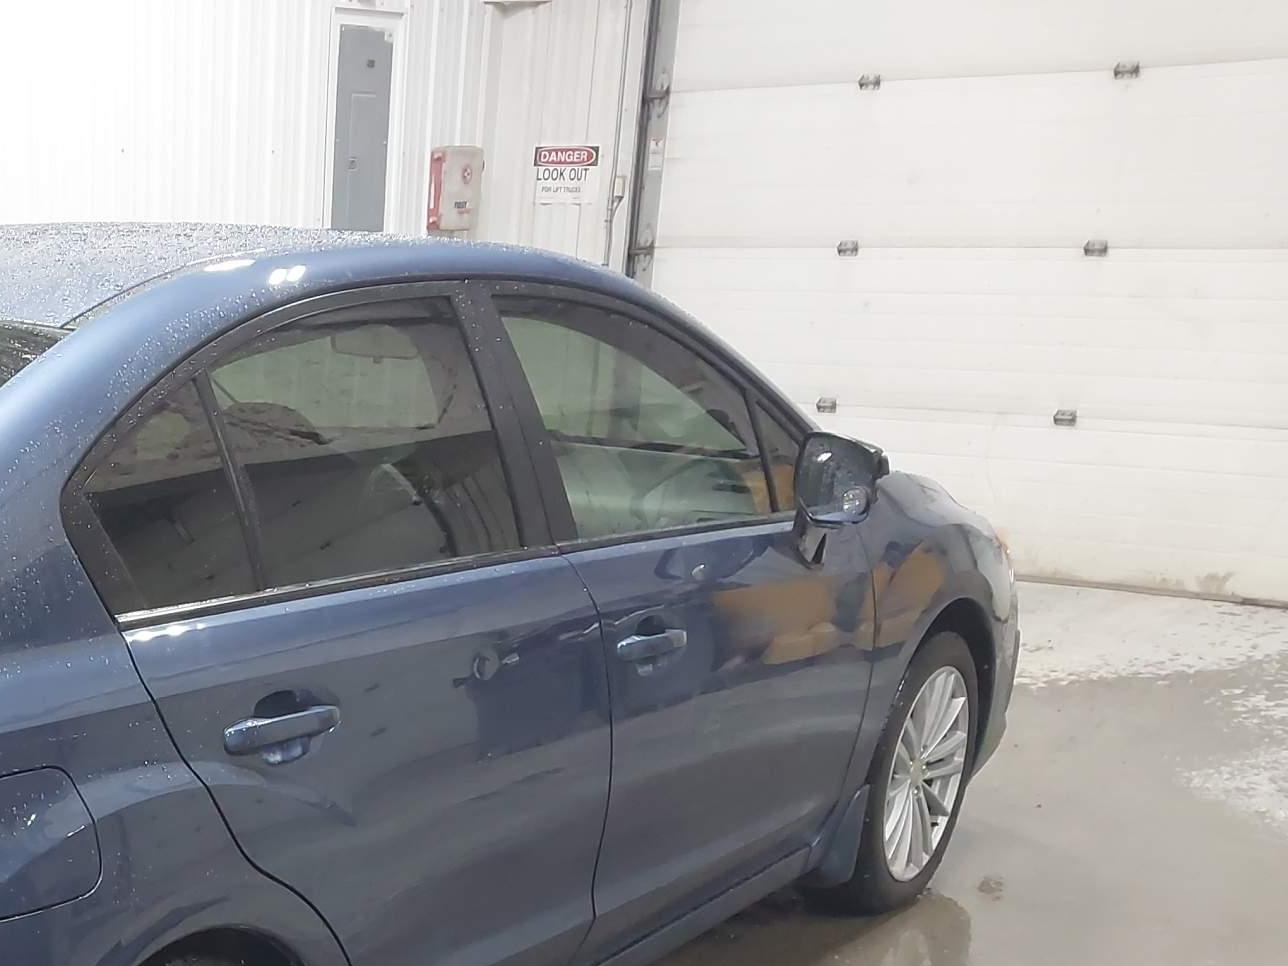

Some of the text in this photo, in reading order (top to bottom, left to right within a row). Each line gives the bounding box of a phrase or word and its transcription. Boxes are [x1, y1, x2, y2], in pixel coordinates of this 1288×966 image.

[540, 151, 588, 162] DANGER
[536, 167, 590, 181] LOOK OUT
